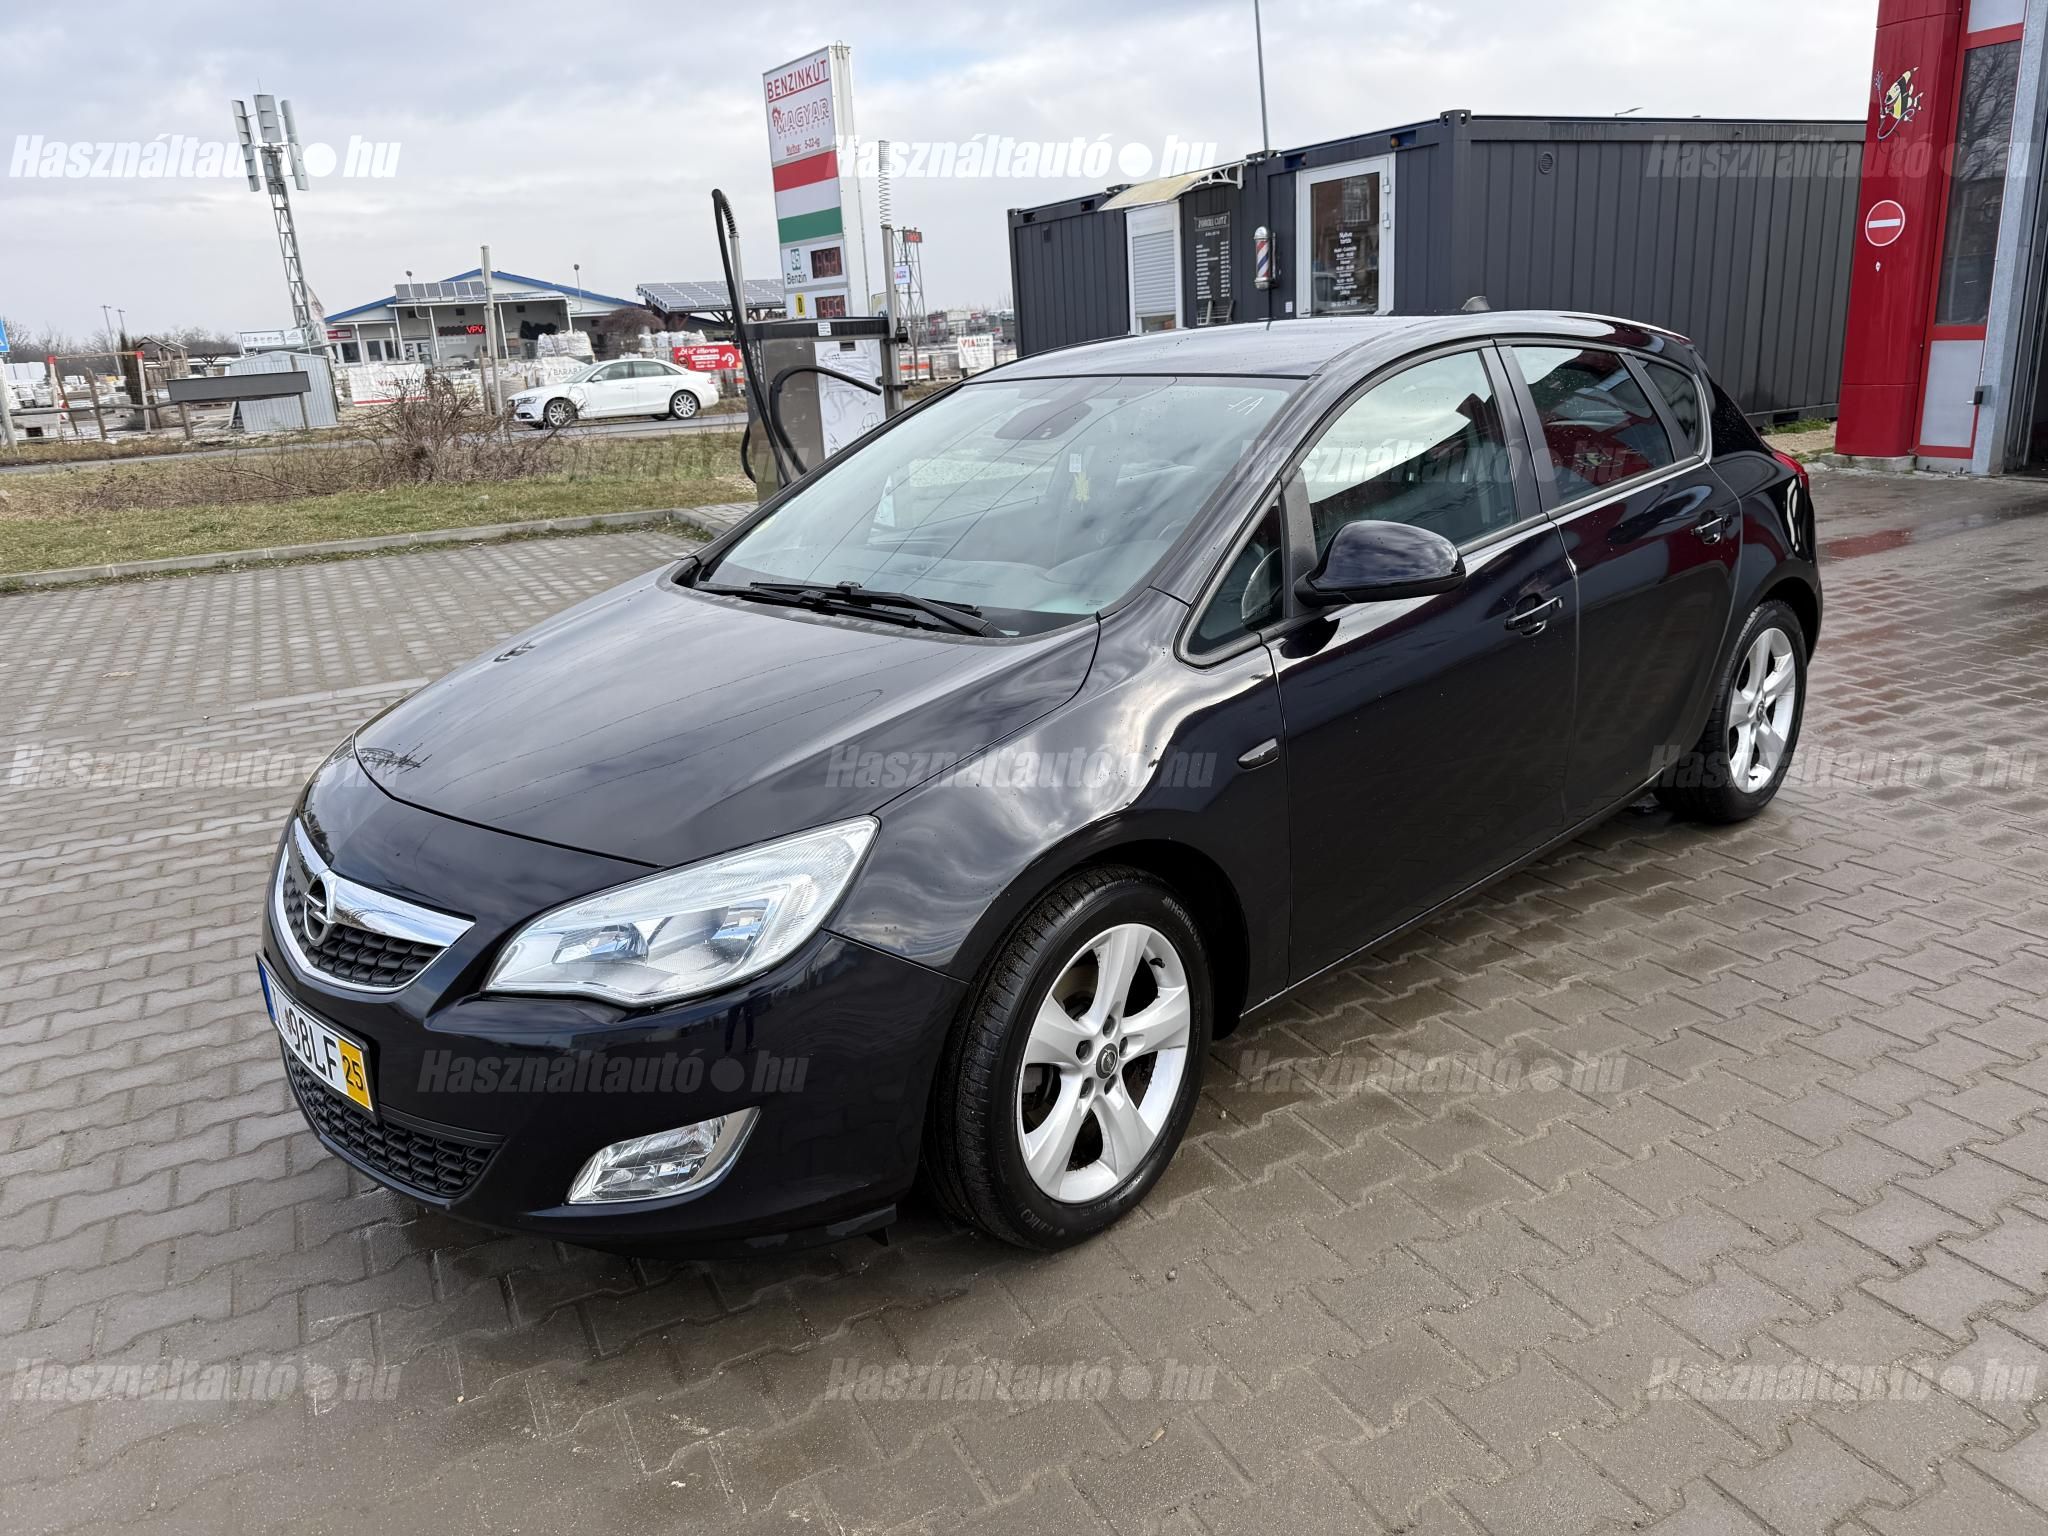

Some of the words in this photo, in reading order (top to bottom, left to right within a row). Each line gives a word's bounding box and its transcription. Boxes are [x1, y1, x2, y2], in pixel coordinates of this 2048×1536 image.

[767, 58, 827, 99] BENZINKÚT
[777, 98, 830, 134] MAGYAR
[786, 270, 808, 285] Benzin
[342, 1055, 364, 1092] 25
